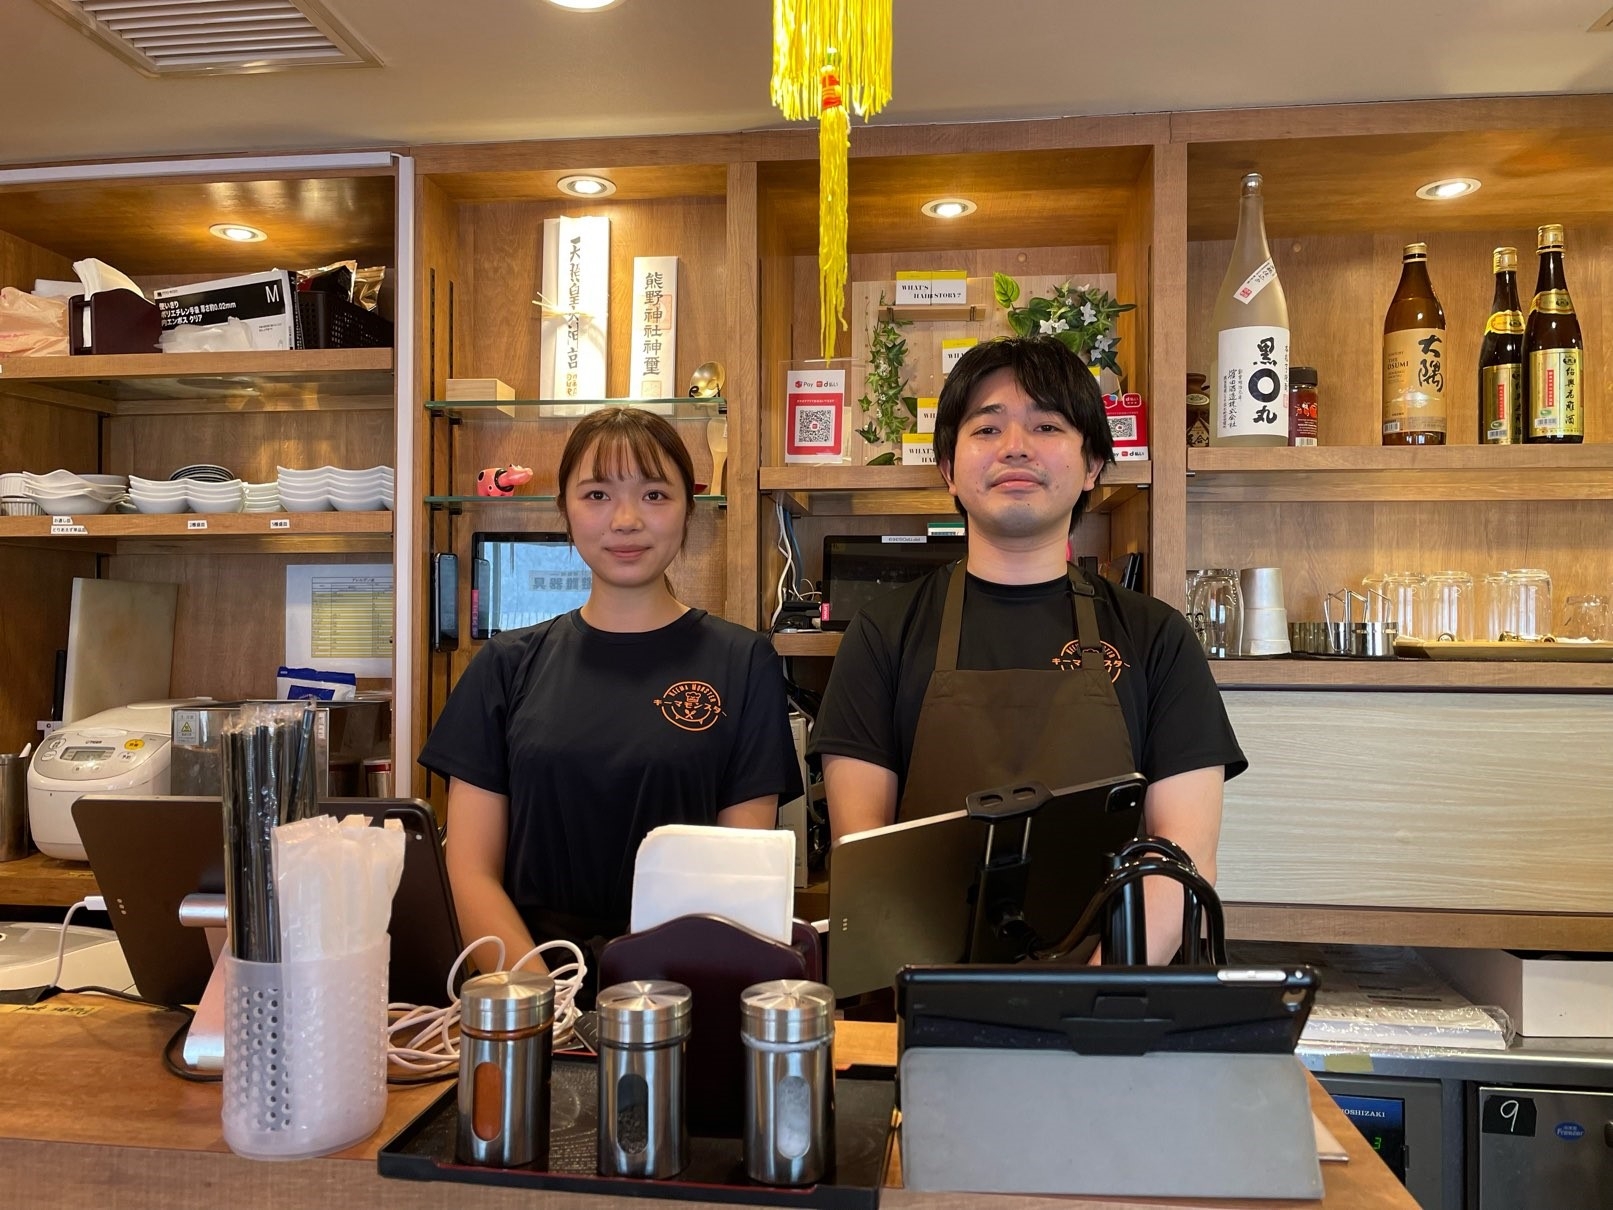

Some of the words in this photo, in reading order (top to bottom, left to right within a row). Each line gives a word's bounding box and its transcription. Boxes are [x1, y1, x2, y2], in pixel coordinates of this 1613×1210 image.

[265, 284, 280, 304] M
[159, 300, 179, 311] 使いきり
[1418, 334, 1444, 393] 大隅
[668, 684, 689, 697] KEEMA
[691, 683, 717, 703] MONSTER
[653, 699, 727, 717] キーマモンスター
[1500, 1099, 1519, 1133] 9
